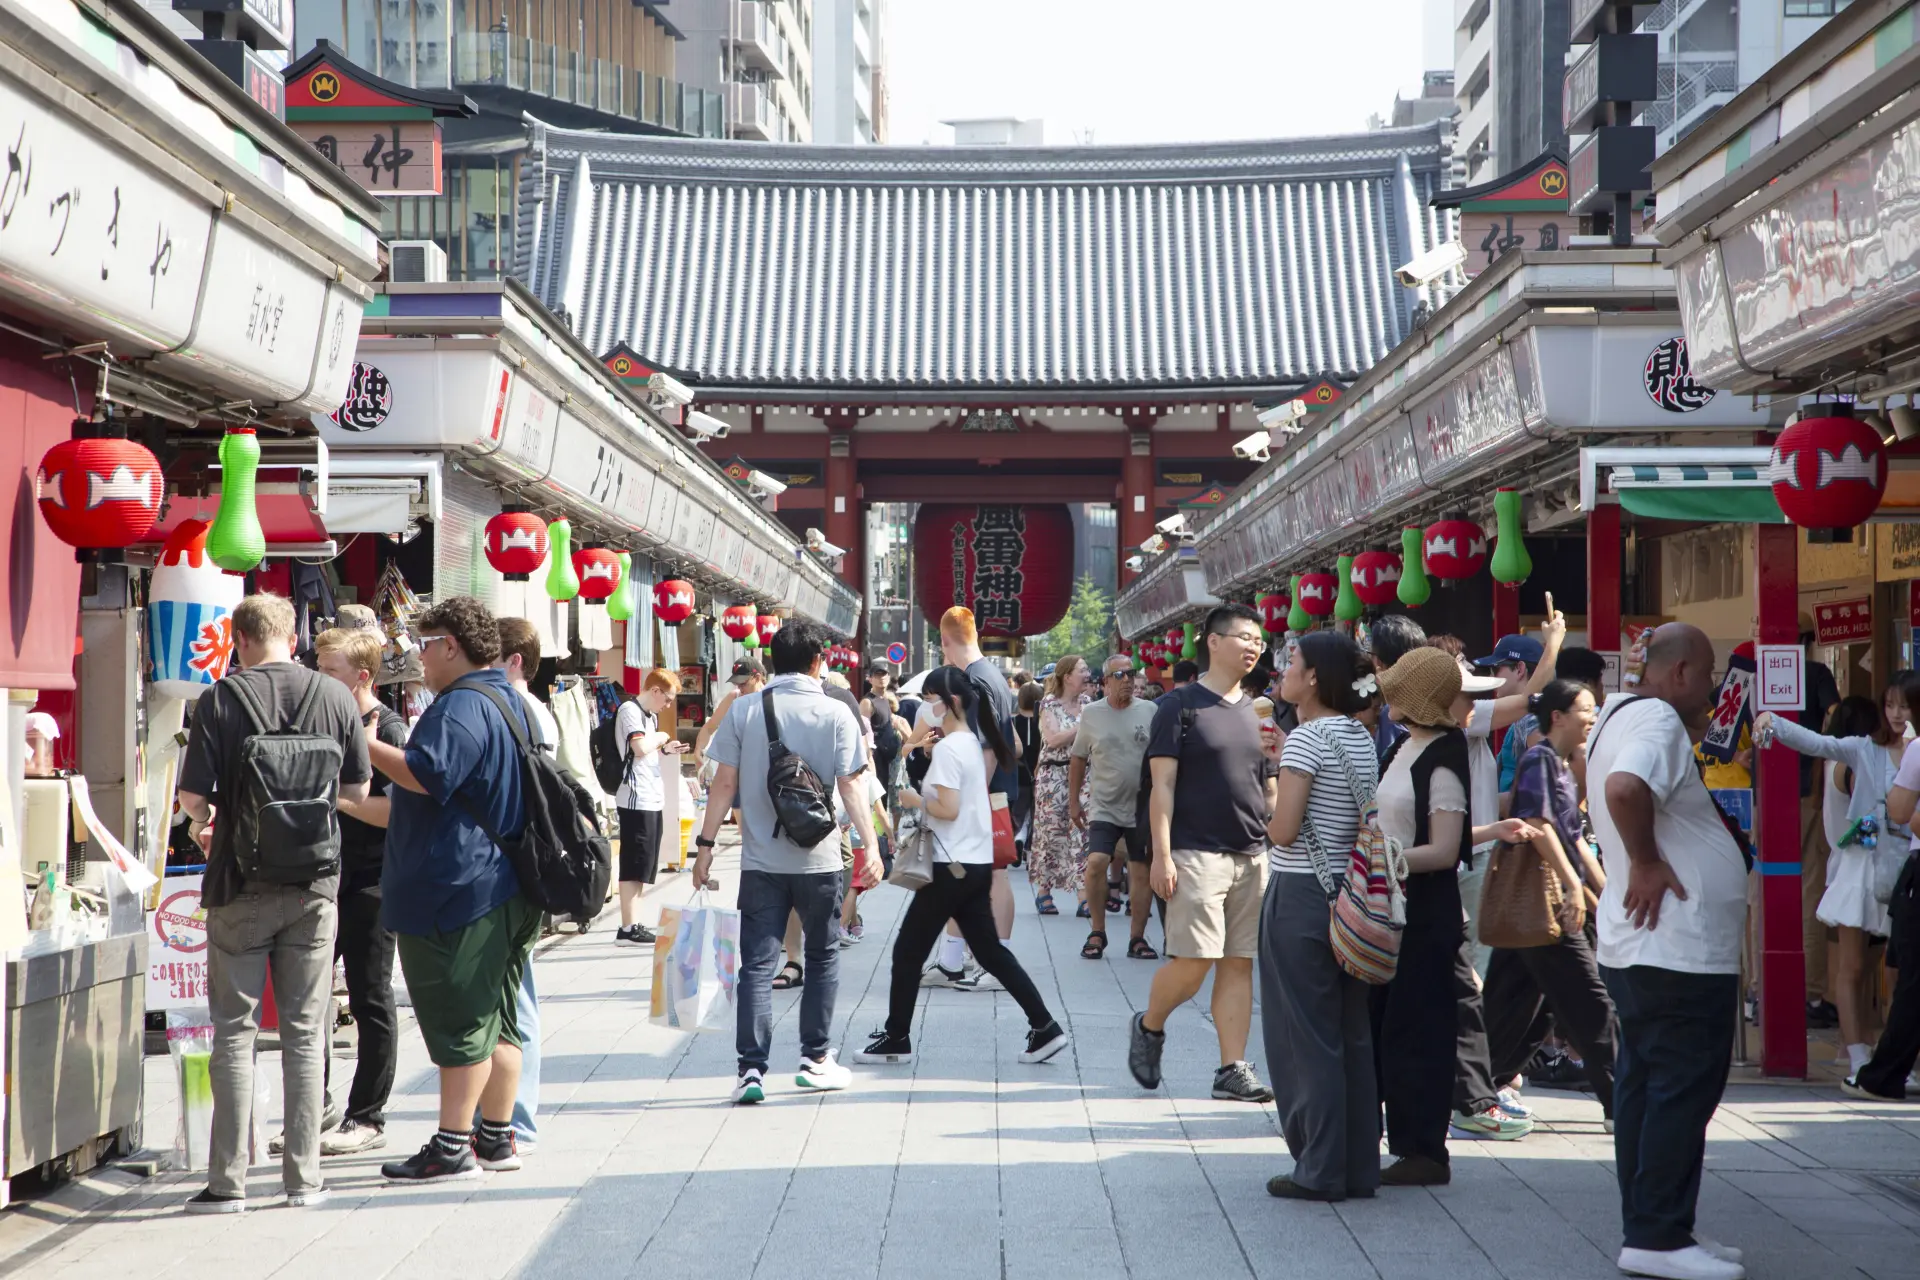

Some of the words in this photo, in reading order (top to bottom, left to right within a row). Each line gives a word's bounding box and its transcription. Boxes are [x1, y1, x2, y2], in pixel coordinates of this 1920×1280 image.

[970, 503, 1027, 632] 風雷神門
[1821, 624, 1850, 637] ORDER
[1769, 656, 1792, 669] 出口
[1770, 683, 1793, 695] Exit
[1713, 682, 1742, 728] 氷
[159, 911, 170, 920] NO
[170, 914, 190, 925] FOOD
